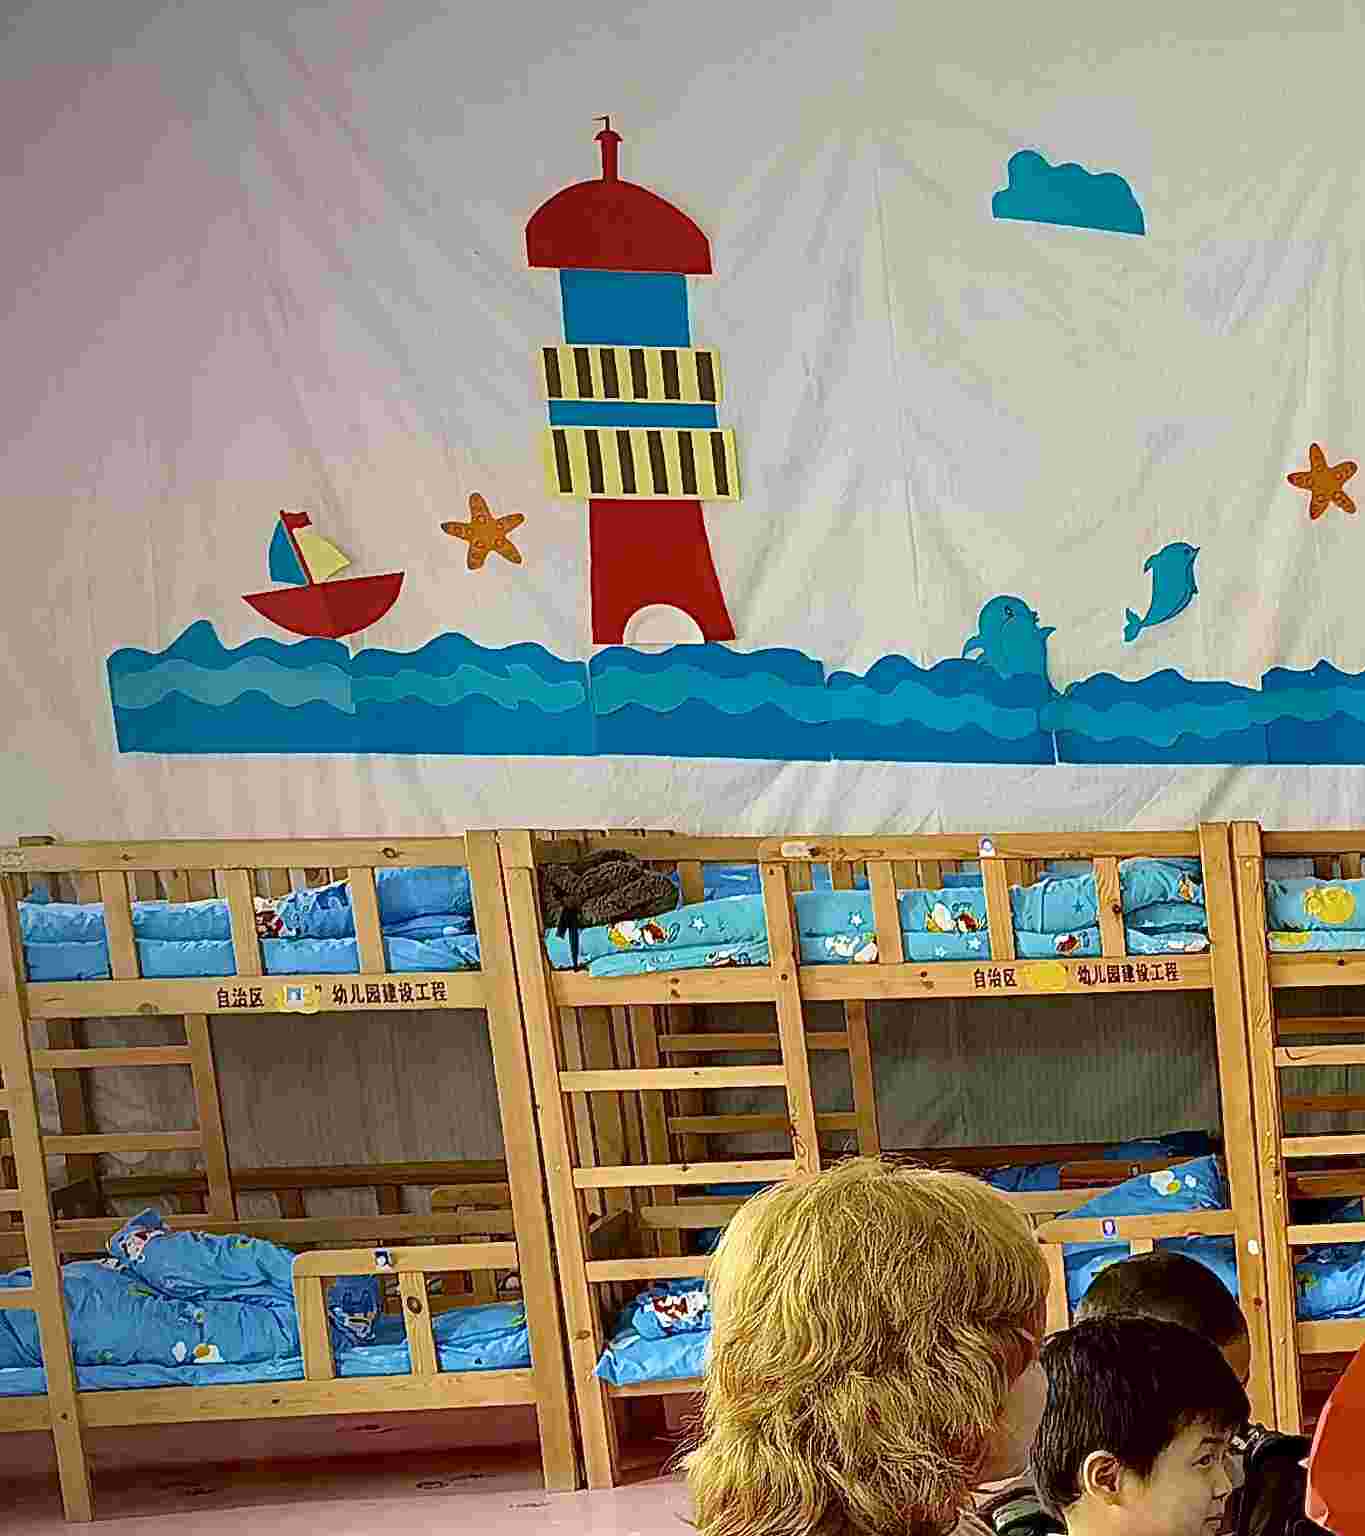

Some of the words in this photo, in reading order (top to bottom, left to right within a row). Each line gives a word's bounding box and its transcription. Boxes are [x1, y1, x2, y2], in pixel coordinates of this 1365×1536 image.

[973, 966, 1018, 989] 自治区
[1076, 960, 1180, 986] 幼儿园建设工程
[216, 986, 265, 1009] 自治区
